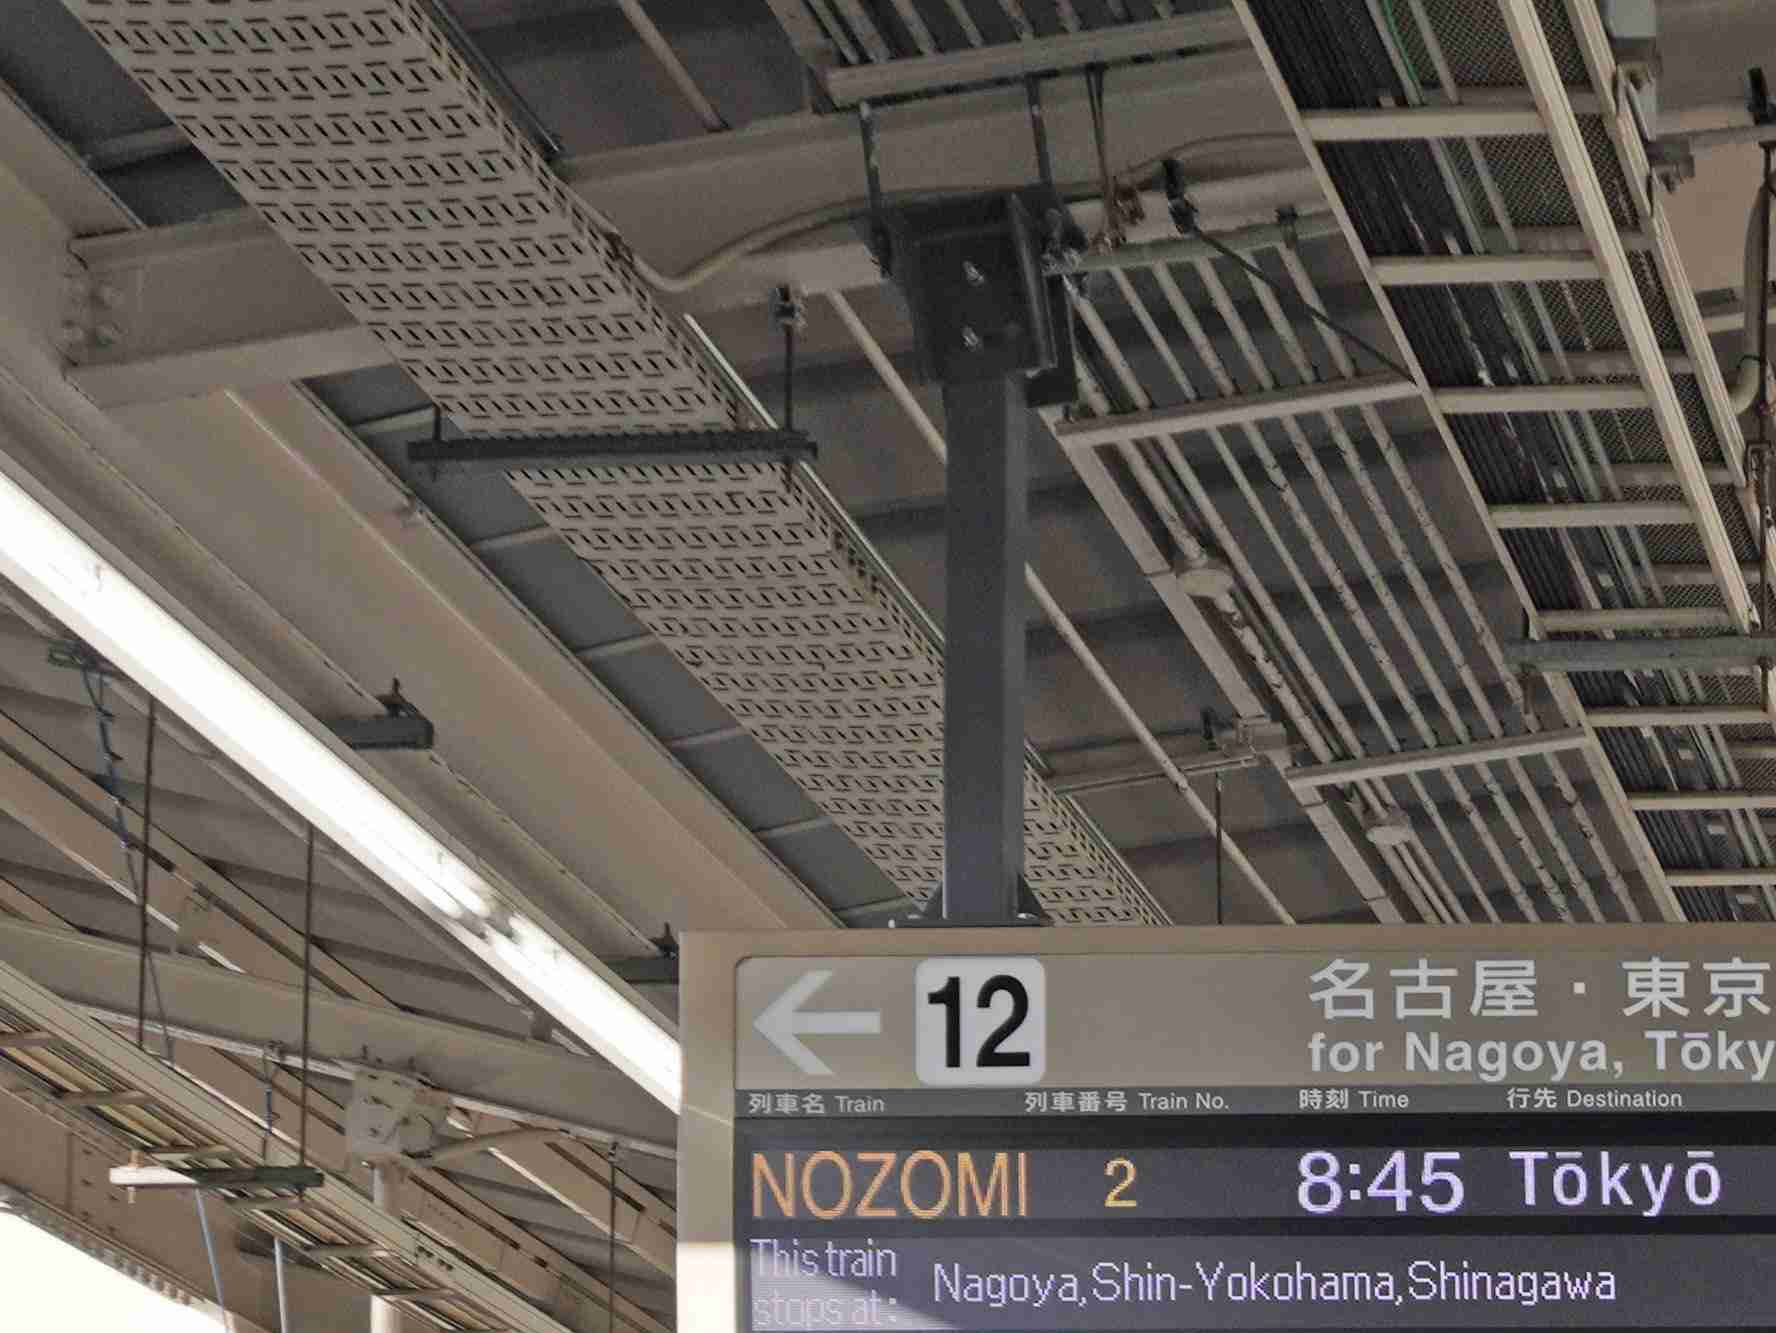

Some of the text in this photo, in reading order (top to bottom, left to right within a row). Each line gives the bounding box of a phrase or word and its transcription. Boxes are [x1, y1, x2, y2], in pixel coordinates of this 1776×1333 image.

[927, 975, 1032, 1069] 12
[1308, 1033, 1392, 1073] for
[1405, 1031, 1624, 1082] Nagoya,
[748, 1092, 885, 1116] 列車名 Train
[1025, 1091, 1229, 1114] 列車番号 Train No.
[1299, 1089, 1410, 1112] 時刻 Time
[1507, 1088, 1682, 1110] 行先 Destination
[751, 1150, 1030, 1220] NOZOMI
[1104, 1158, 1137, 1208] 2
[1298, 1152, 1466, 1214] 8:45
[1510, 1150, 1721, 1218] Tōkyō
[751, 1239, 896, 1278] This train
[753, 1290, 898, 1329] stops at:
